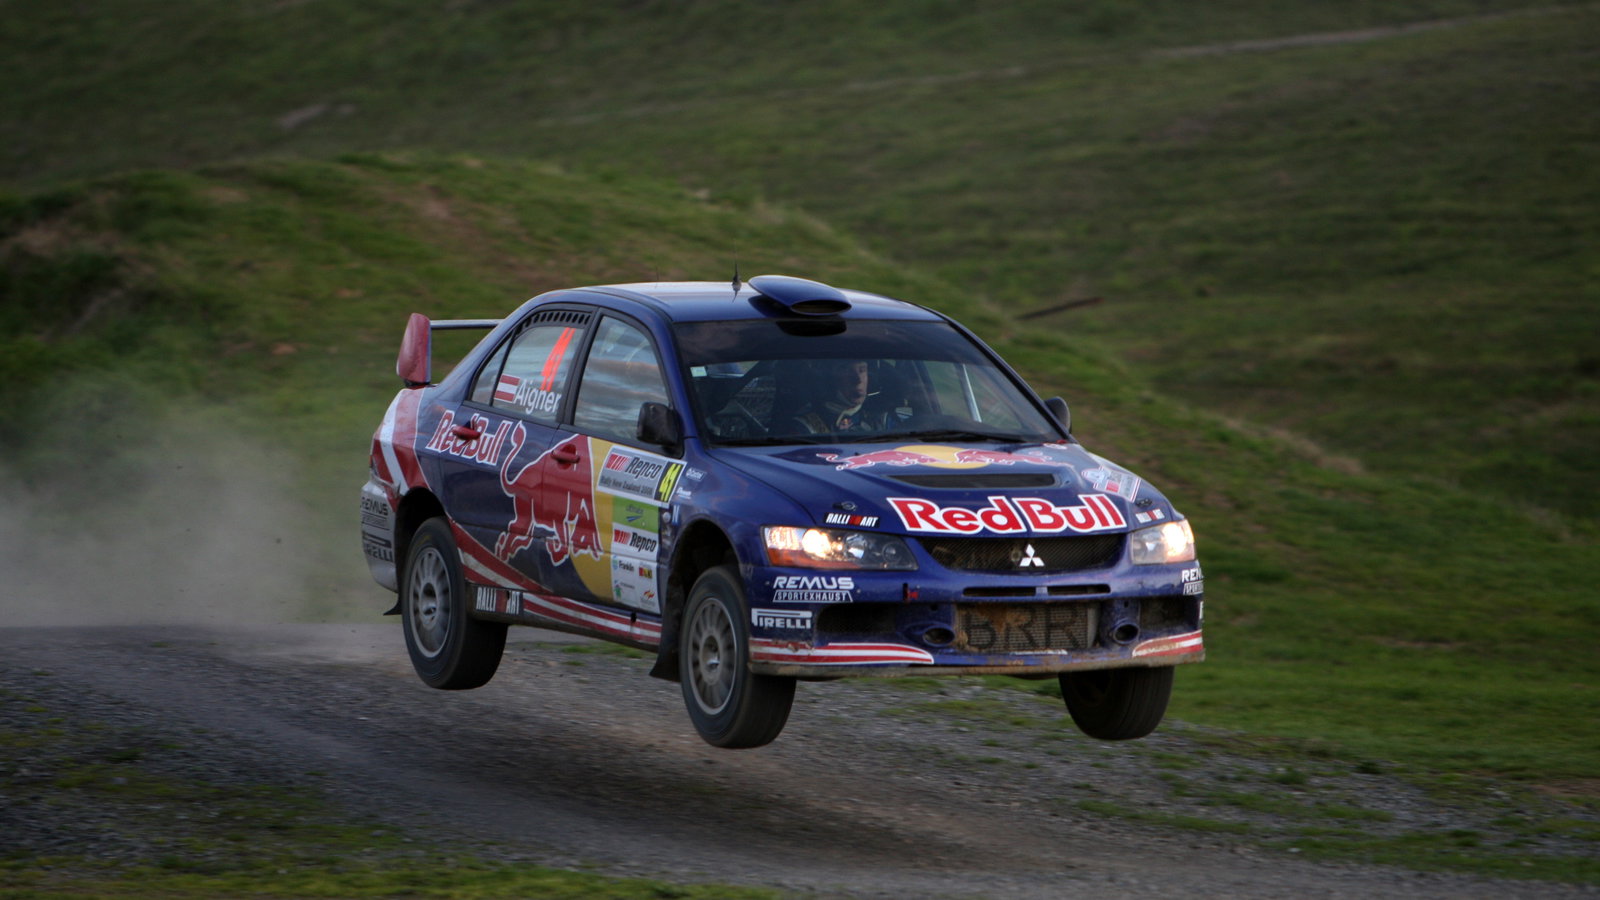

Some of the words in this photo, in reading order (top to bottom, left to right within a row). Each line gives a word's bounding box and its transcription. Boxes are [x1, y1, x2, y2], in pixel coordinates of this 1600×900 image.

[513, 379, 562, 415] Aigner
[461, 416, 513, 466] Bull
[625, 456, 662, 479] Repco
[887, 496, 1027, 534] Red
[1012, 493, 1128, 533] Bull
[629, 531, 657, 552] Repco
[773, 576, 854, 590] REMUS
[777, 591, 848, 602] SPORTEXHAUST
[751, 608, 813, 630] PIRELLI
